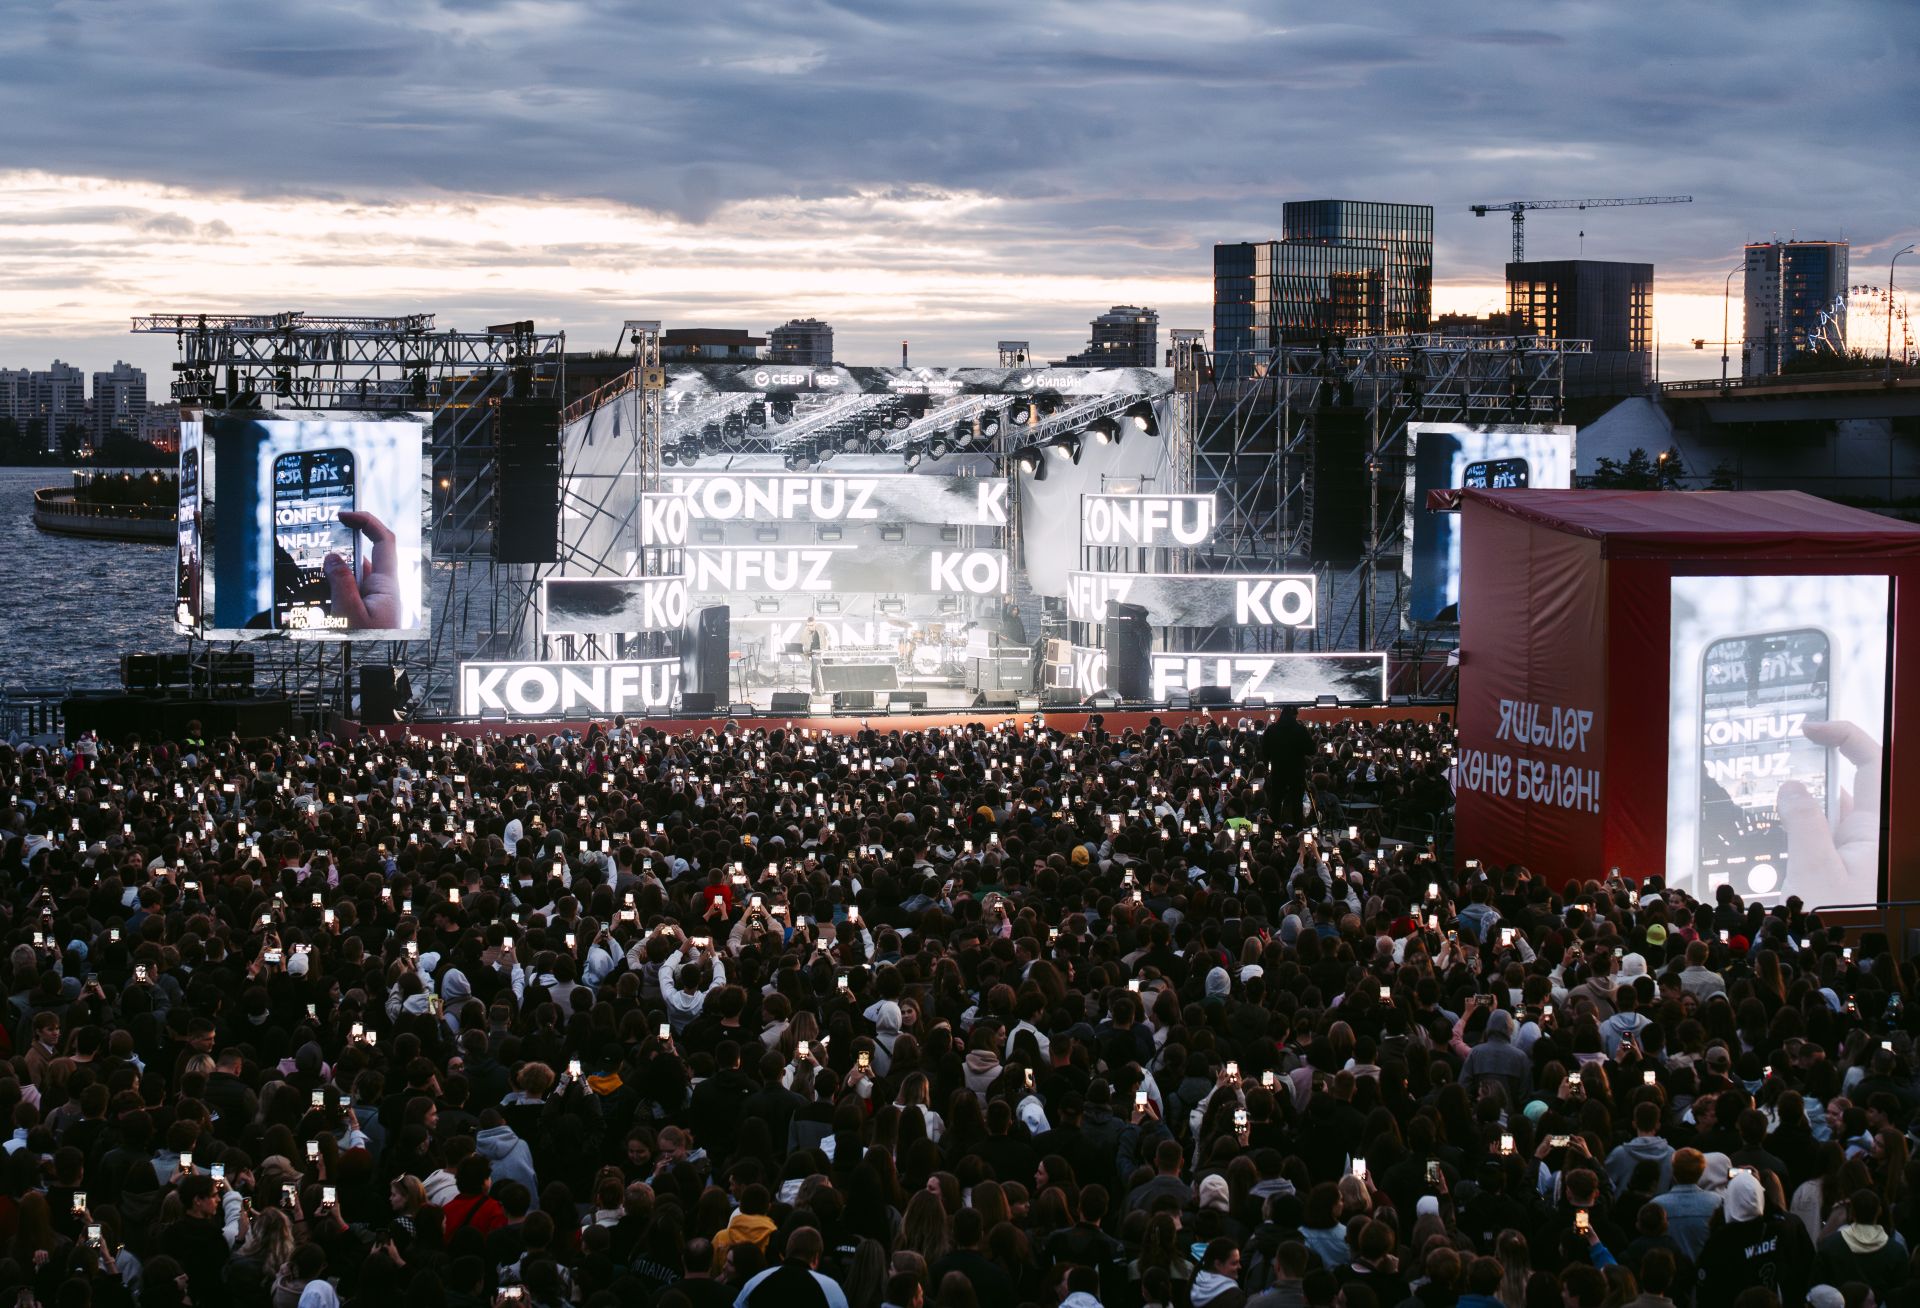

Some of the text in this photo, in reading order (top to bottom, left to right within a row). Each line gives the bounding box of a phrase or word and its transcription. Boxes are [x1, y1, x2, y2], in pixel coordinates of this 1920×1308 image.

[772, 374, 804, 385] СБЕР
[1037, 374, 1081, 387] билайн
[673, 478, 879, 519] KONFUZ
[978, 482, 1007, 522] K
[1236, 579, 1312, 625] KO
